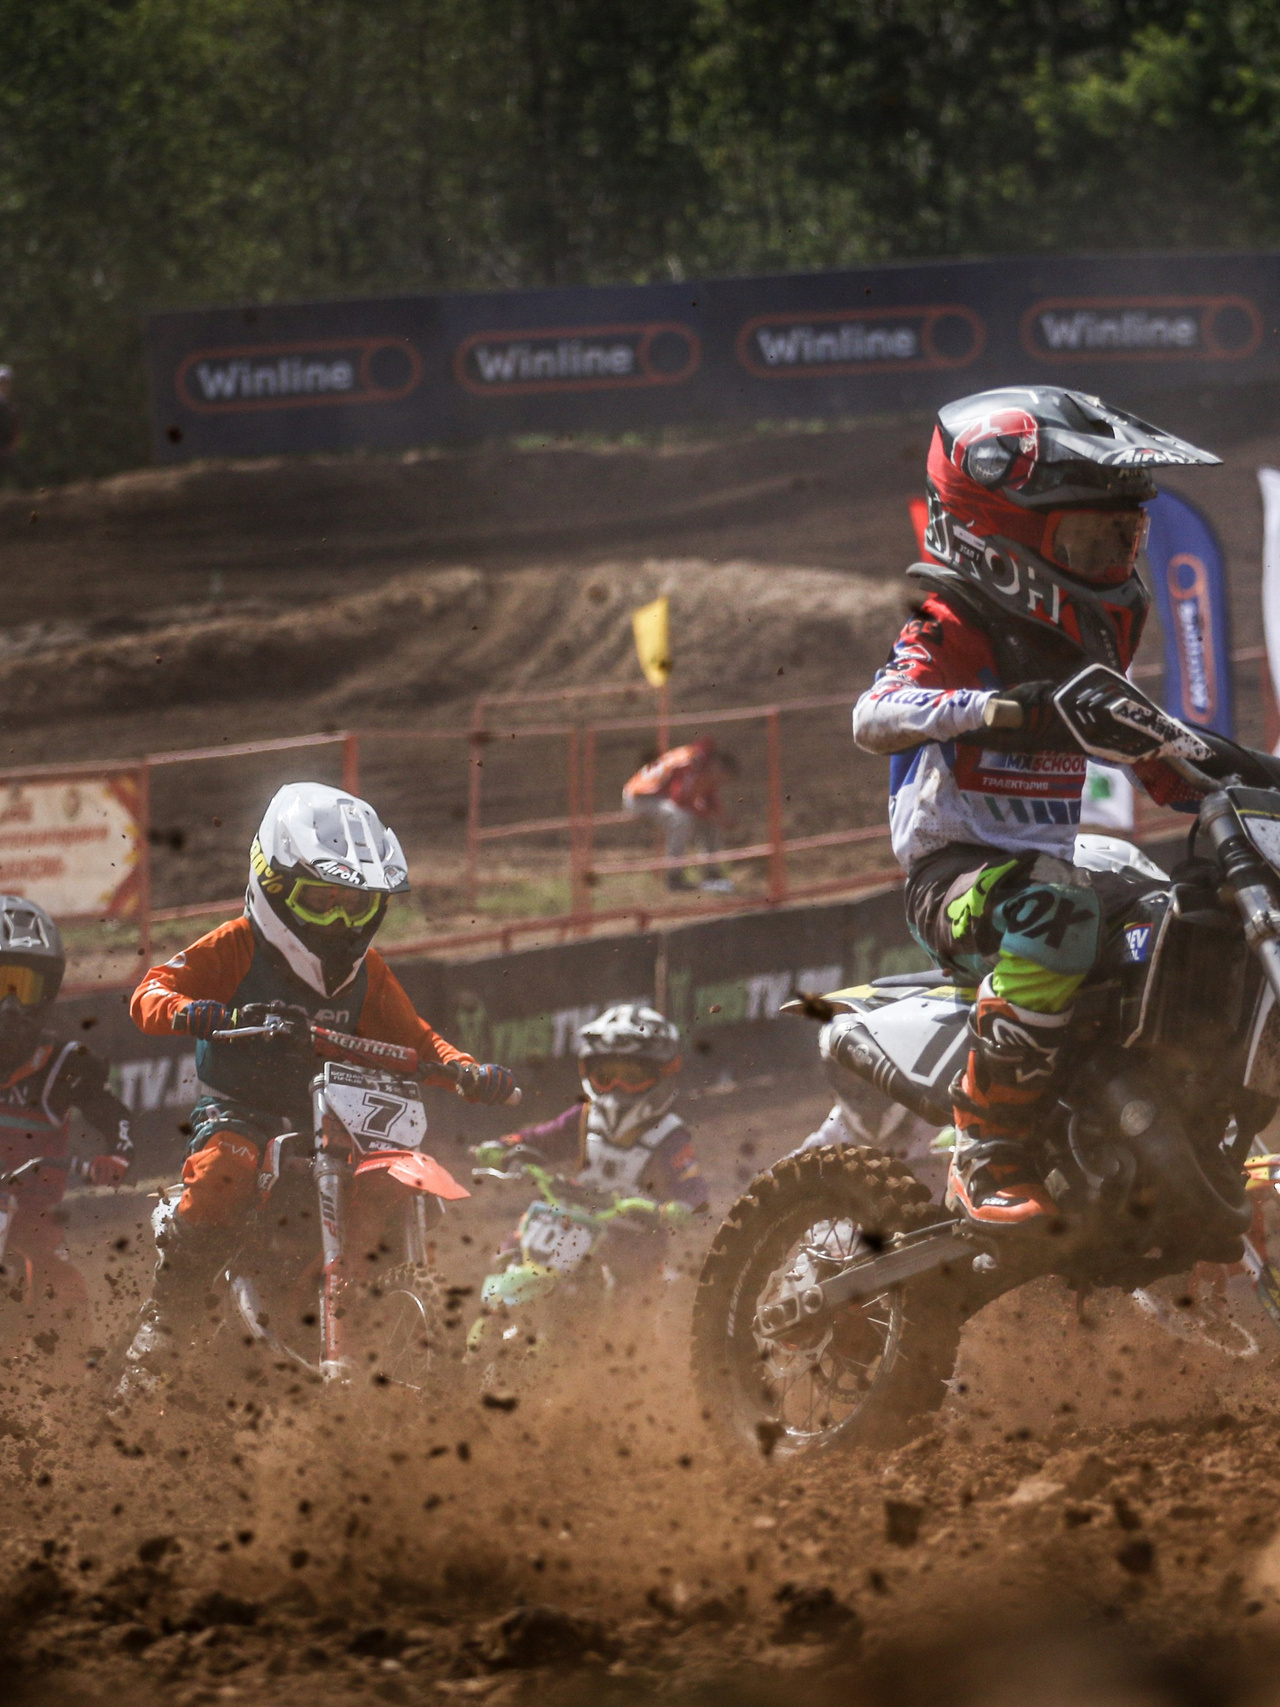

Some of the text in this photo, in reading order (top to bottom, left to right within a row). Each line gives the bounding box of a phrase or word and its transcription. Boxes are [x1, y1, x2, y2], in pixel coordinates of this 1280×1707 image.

[756, 328, 916, 364] Winline
[1039, 312, 1198, 350] Winline
[197, 359, 354, 399] Winline
[475, 345, 634, 383] Winline
[318, 861, 360, 885] Airoh
[1002, 889, 1096, 949] OX
[327, 1034, 408, 1060] RENTHAL
[362, 1091, 408, 1138] 7
